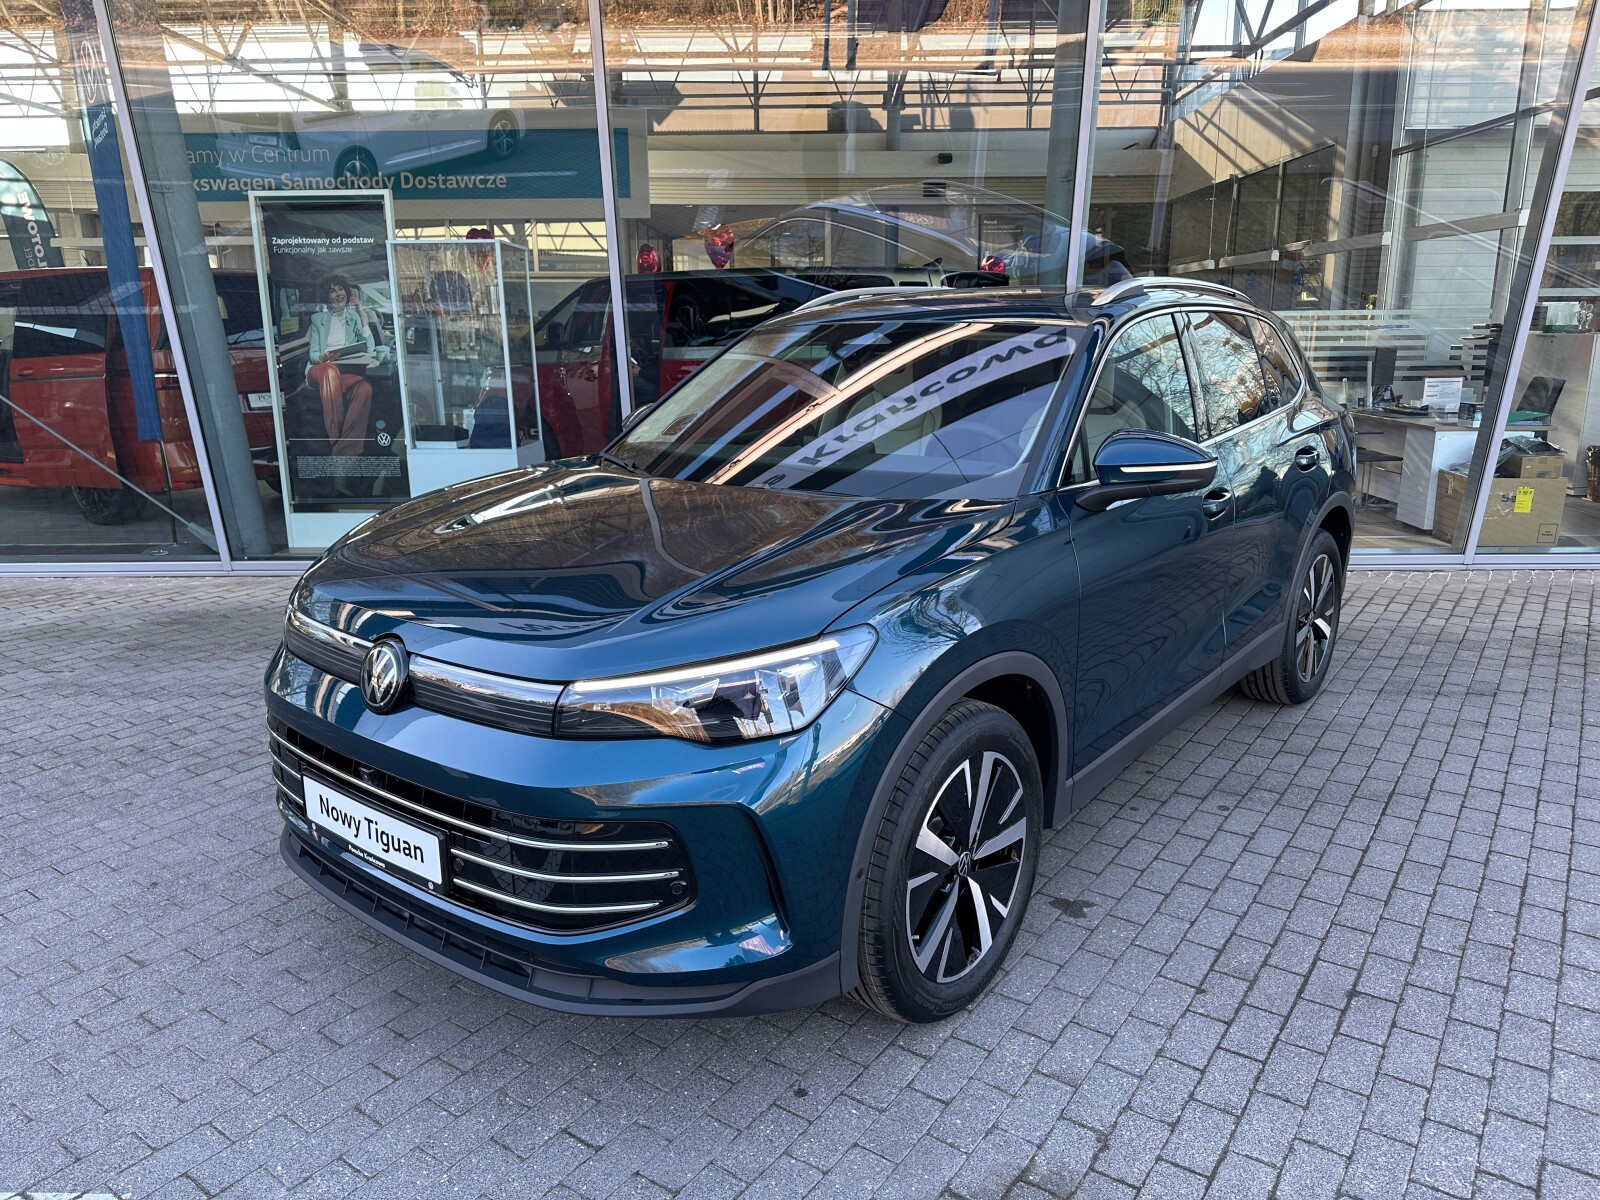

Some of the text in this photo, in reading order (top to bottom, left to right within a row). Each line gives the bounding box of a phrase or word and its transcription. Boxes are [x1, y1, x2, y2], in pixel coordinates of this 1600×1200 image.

[229, 150, 245, 163] w
[252, 145, 330, 163] Centrum
[281, 172, 394, 190] Samochody
[400, 171, 507, 189] Dostawcze
[271, 236, 375, 247] Zaprojektowany od podstaw
[273, 246, 316, 255] Funkcjonalny
[317, 246, 327, 255] jak
[318, 793, 425, 864] Nowy Tiguan
